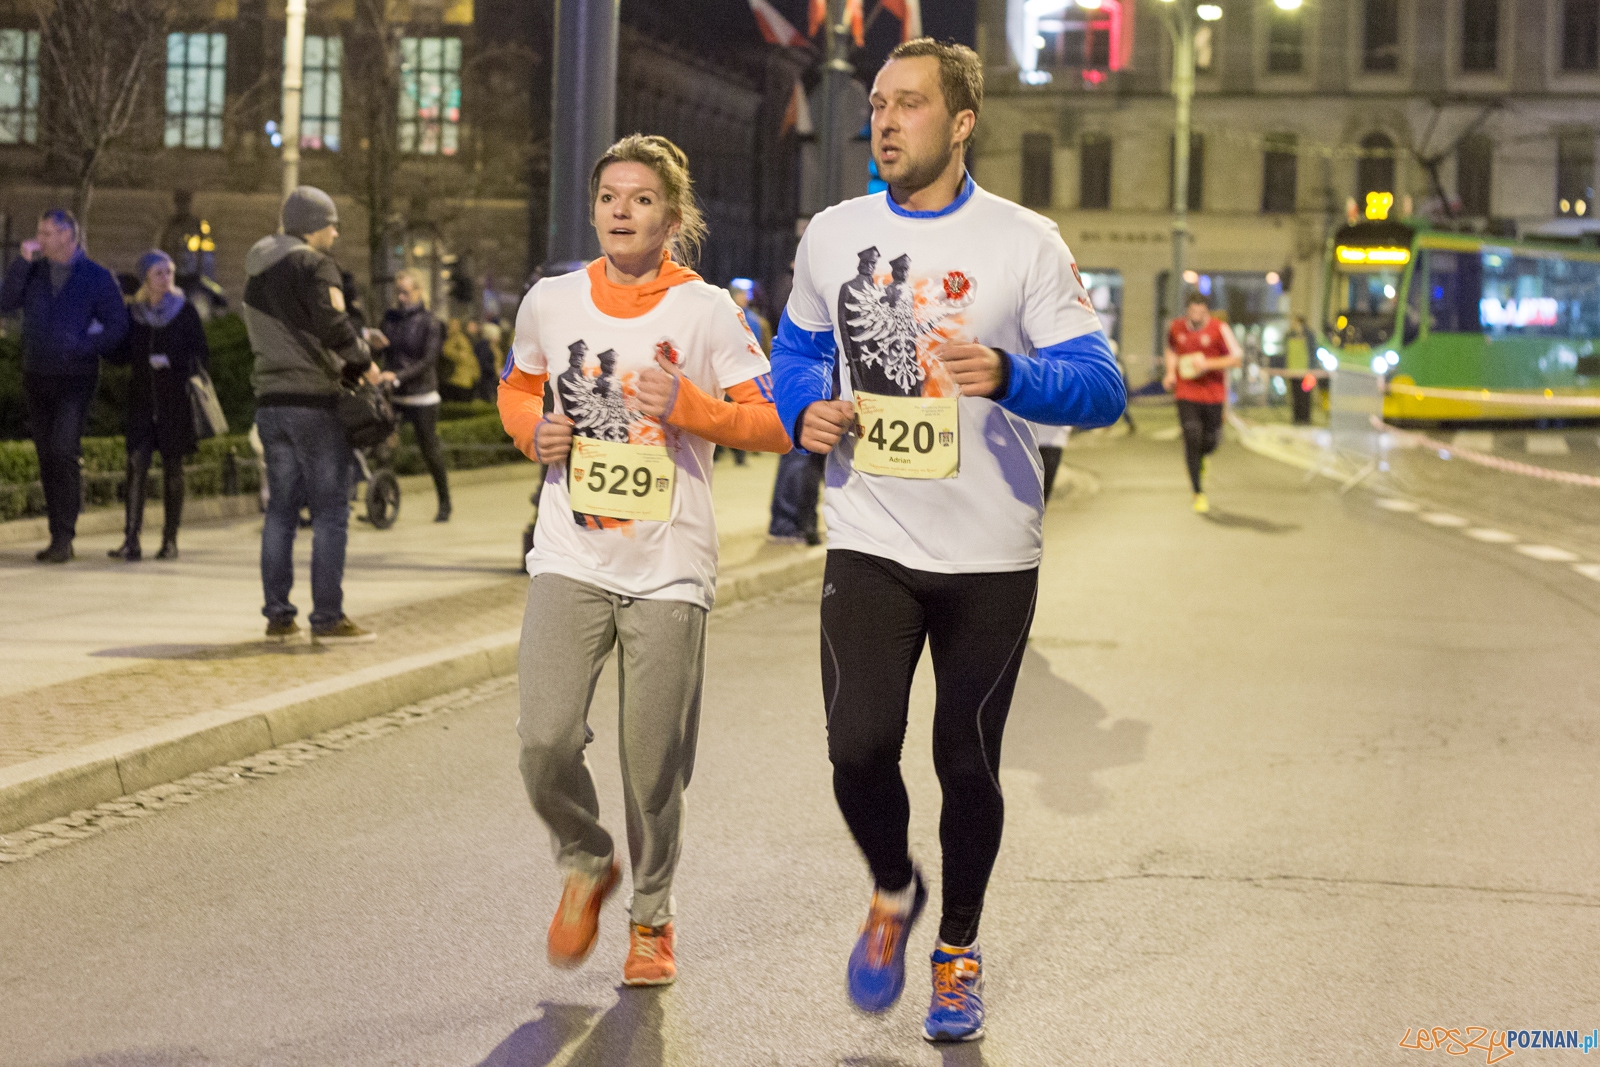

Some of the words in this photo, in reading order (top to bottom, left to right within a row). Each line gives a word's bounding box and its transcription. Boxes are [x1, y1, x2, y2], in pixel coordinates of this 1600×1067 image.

[868, 418, 935, 454] 420
[889, 456, 912, 465] Adrian
[587, 461, 652, 498] 529
